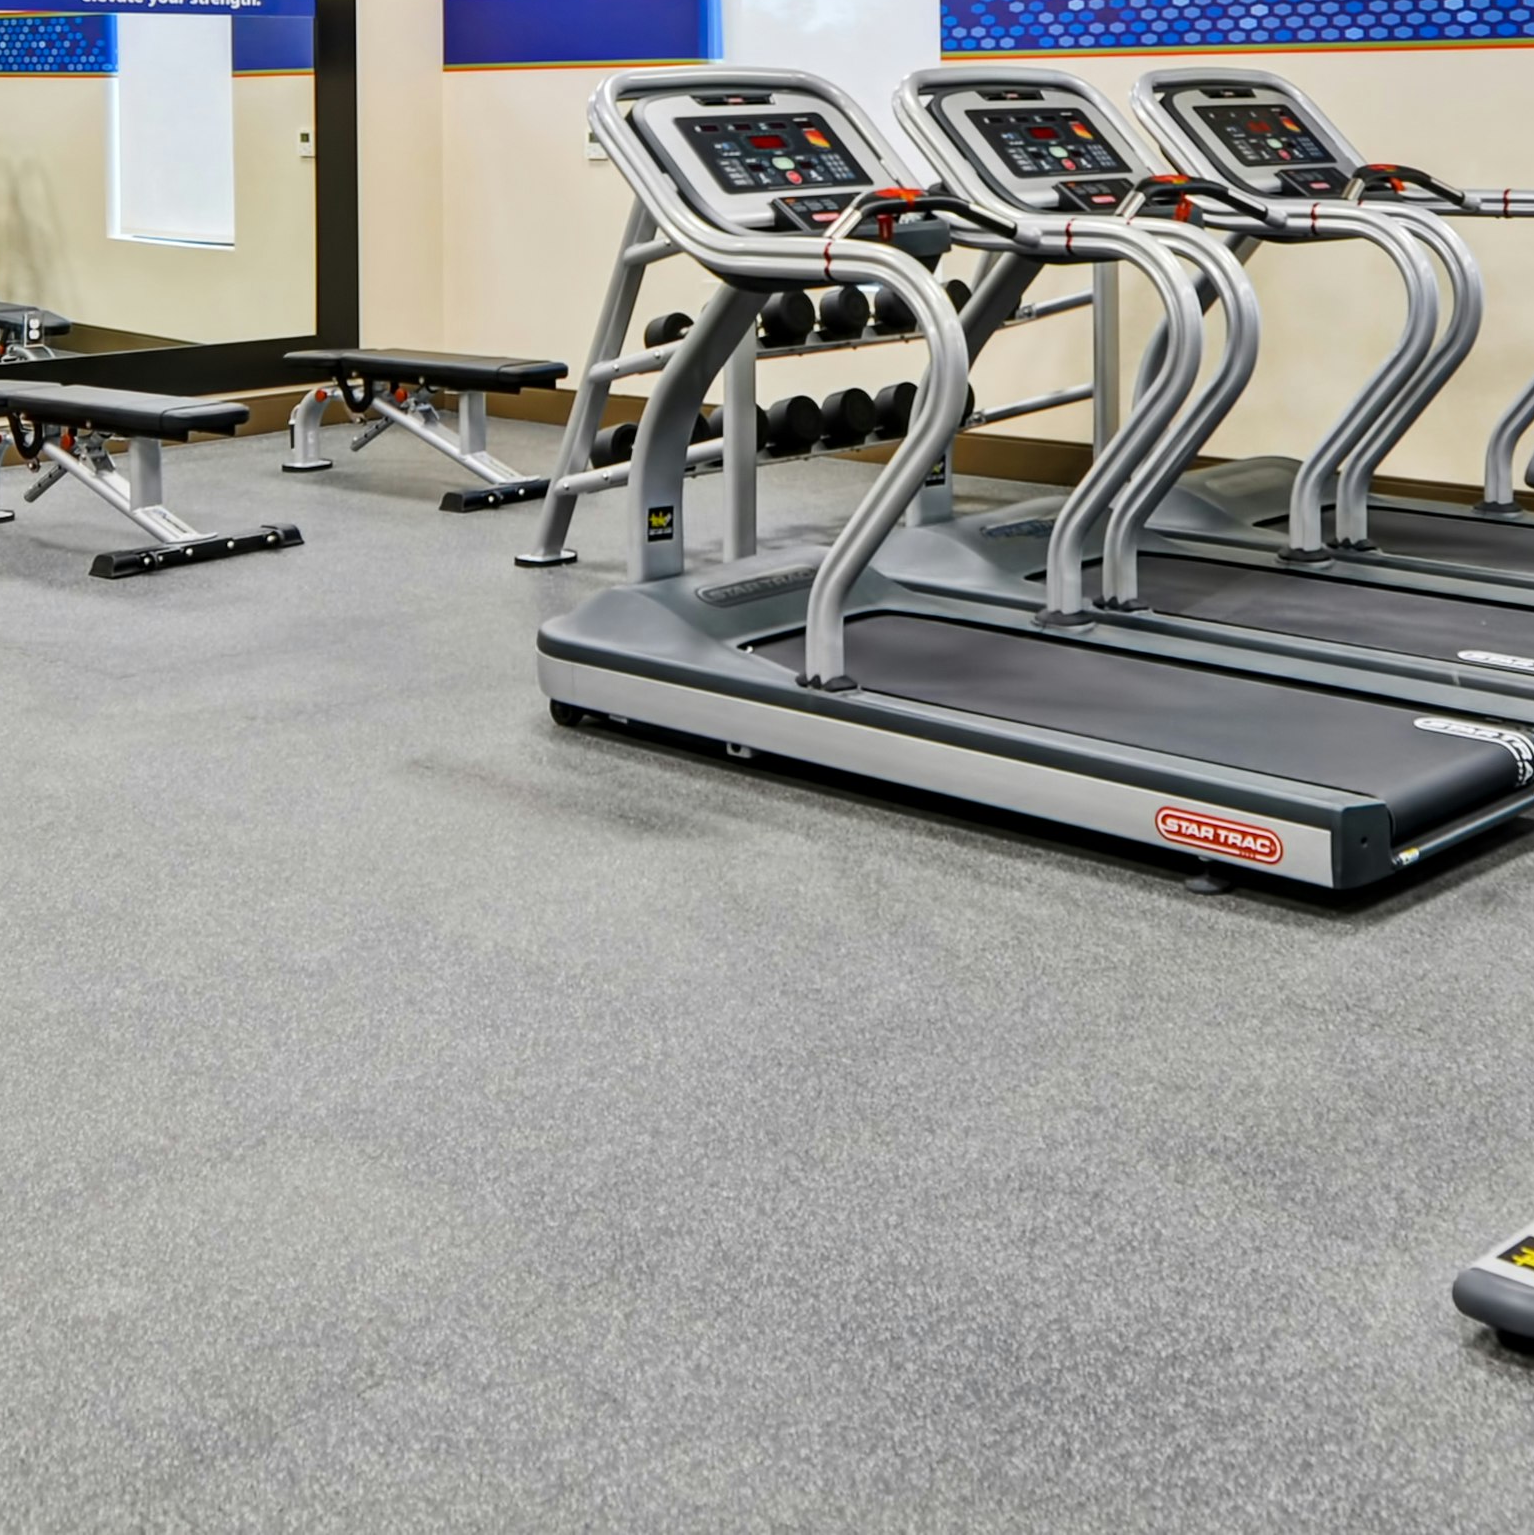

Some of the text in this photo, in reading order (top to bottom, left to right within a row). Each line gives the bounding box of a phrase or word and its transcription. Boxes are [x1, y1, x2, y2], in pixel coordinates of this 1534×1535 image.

[1500, 733, 1534, 785] TRA
[1164, 817, 1271, 854] STAR TRAC
